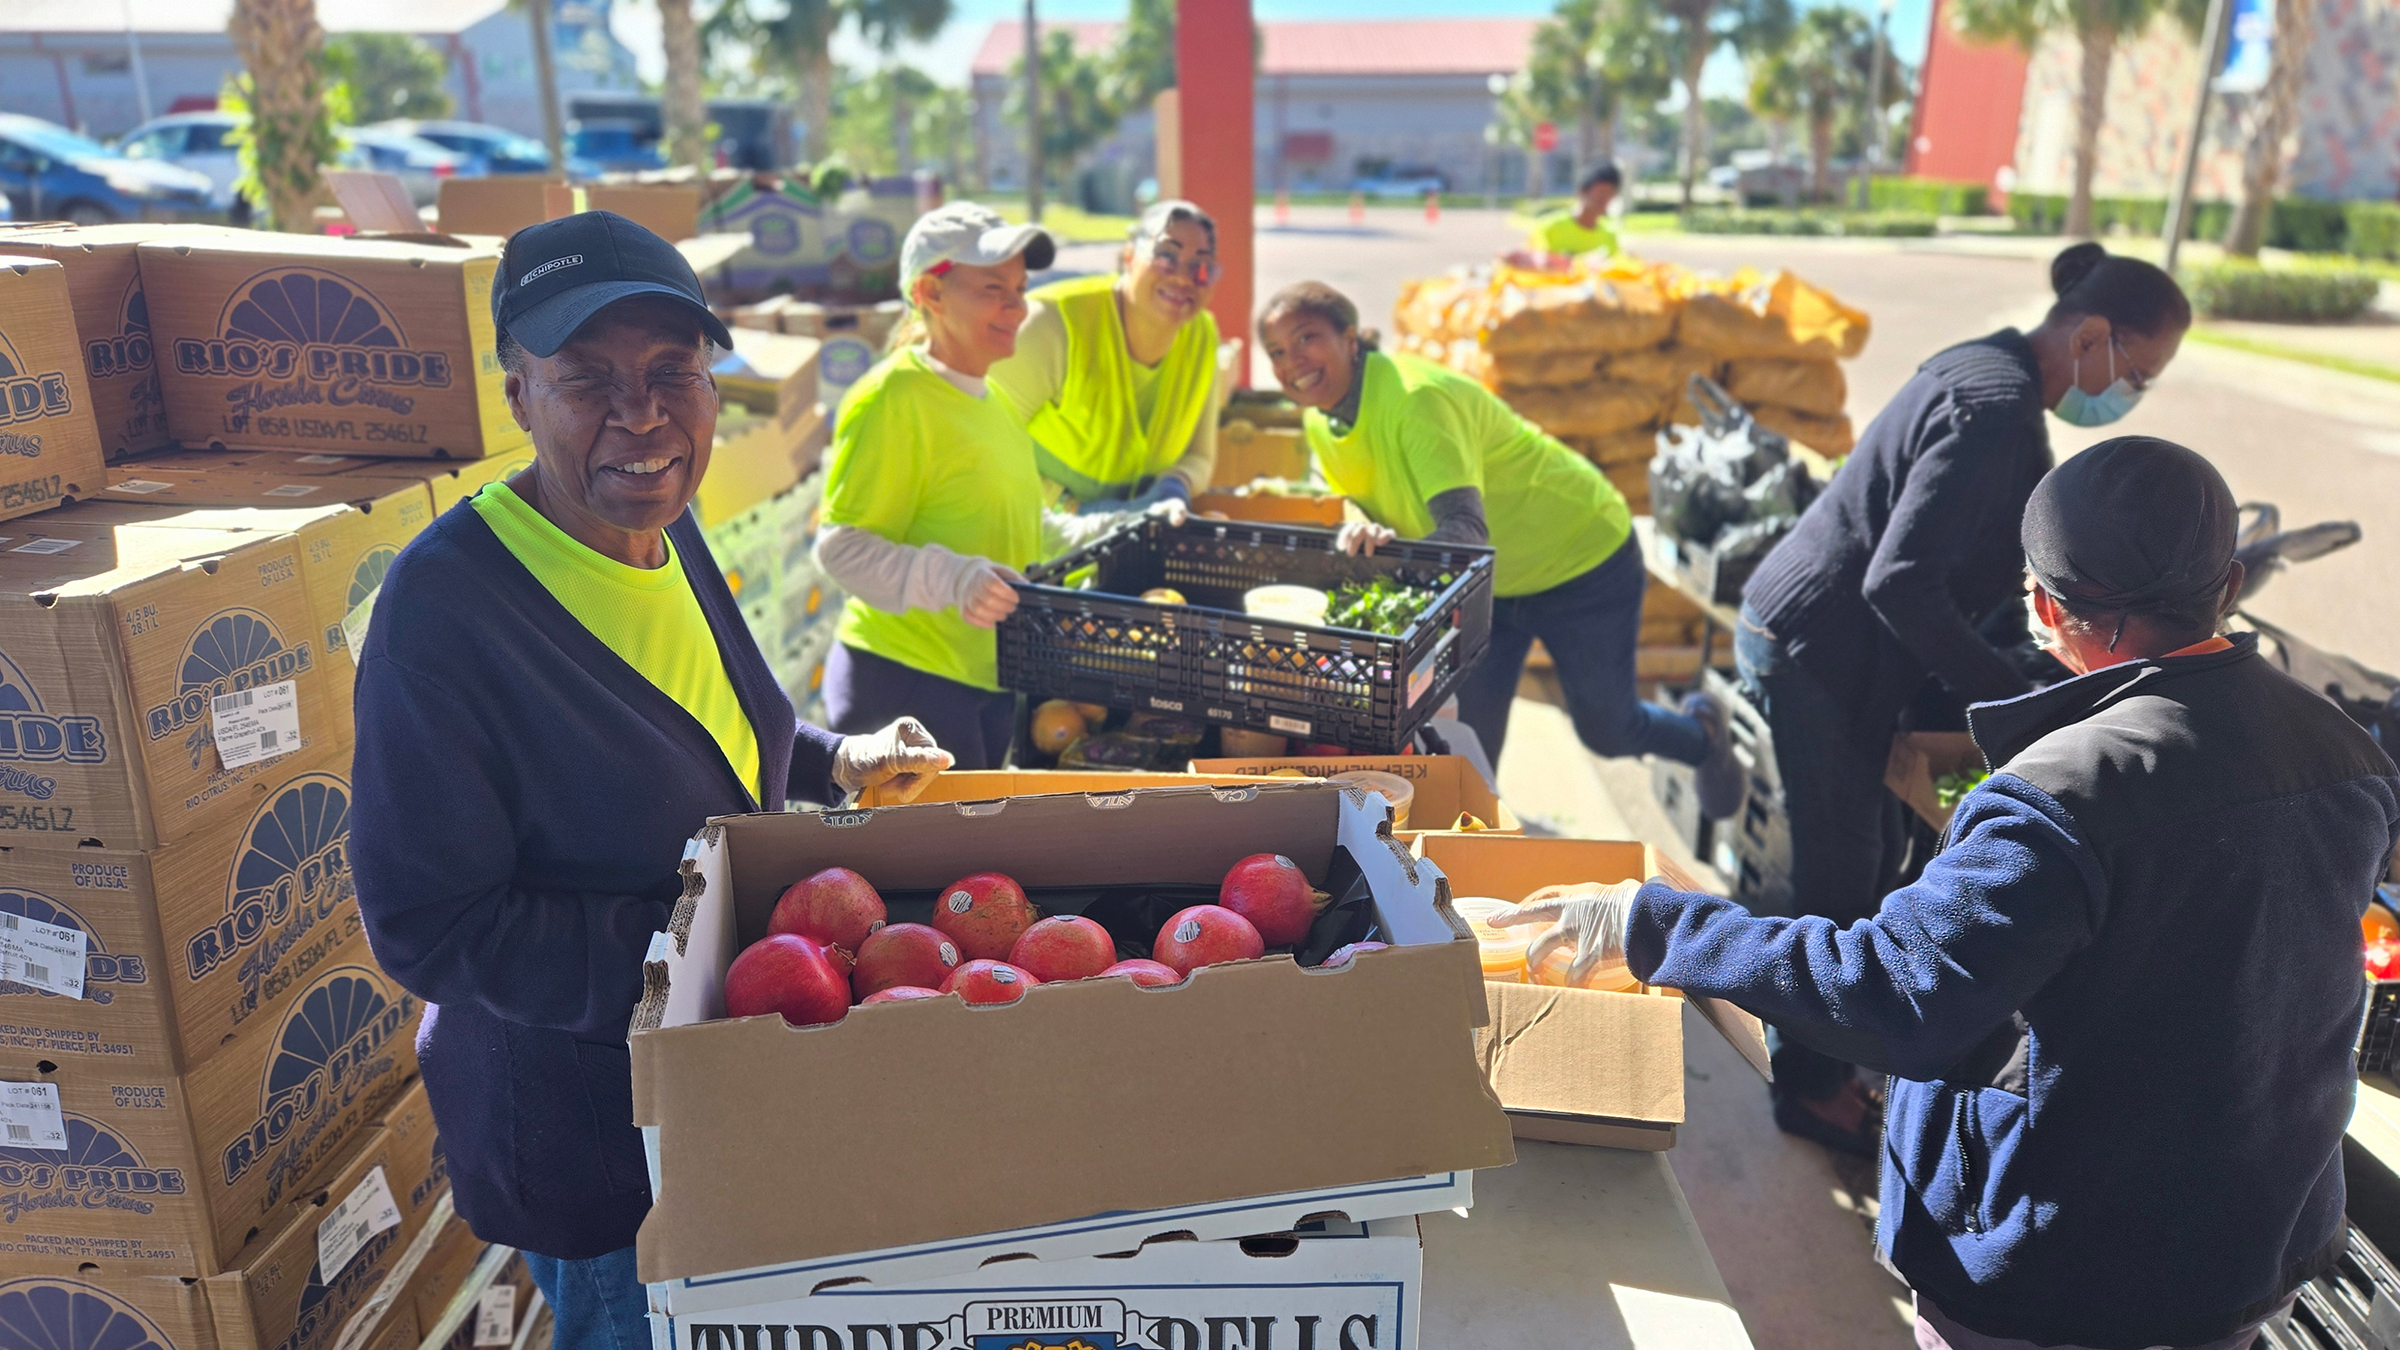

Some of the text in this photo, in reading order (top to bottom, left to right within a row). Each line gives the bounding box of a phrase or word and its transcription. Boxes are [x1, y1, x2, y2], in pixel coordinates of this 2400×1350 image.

[532, 255, 579, 277] CHIPOTLE
[174, 337, 300, 380] RIO'S
[303, 341, 451, 388] PRIDE
[226, 376, 415, 416] Florida Citrus
[257, 555, 294, 576] PRODUCE
[262, 576, 273, 587] OF
[126, 608, 142, 624] 4/5
[131, 619, 151, 636] 28.1
[230, 641, 312, 692] PRIDE
[1150, 695, 1183, 712] tosca
[1207, 707, 1233, 720] 65170
[185, 795, 200, 810] RIO
[72, 863, 128, 878] PRODUCE
[75, 875, 128, 889] OF U.S.A.
[35, 926, 51, 936] LOT
[59, 930, 75, 943] 061
[186, 873, 294, 981] RIO'S
[68, 979, 79, 988] 32
[20, 1026, 41, 1037] AND
[45, 1029, 84, 1041] SHIPPED
[88, 1032, 100, 1042] BY
[51, 1040, 88, 1053] PIERCE,
[90, 1043, 101, 1053] FL
[103, 1044, 135, 1055] 34951
[8, 1087, 22, 1095] LOT
[31, 1086, 47, 1096] 061
[111, 1086, 165, 1098] PRODUCE
[115, 1097, 166, 1109] OF U.S.A.
[223, 1068, 323, 1187] RIO'S
[50, 1132, 60, 1140] 32
[60, 1165, 186, 1195] PRIDE
[0, 1187, 155, 1223] Florida Citrus
[25, 1234, 143, 1249] PACKED AND SHIPPED BY
[134, 1250, 144, 1259] FL
[147, 1249, 176, 1260] 34951
[986, 1304, 1104, 1331] PREMIUM
